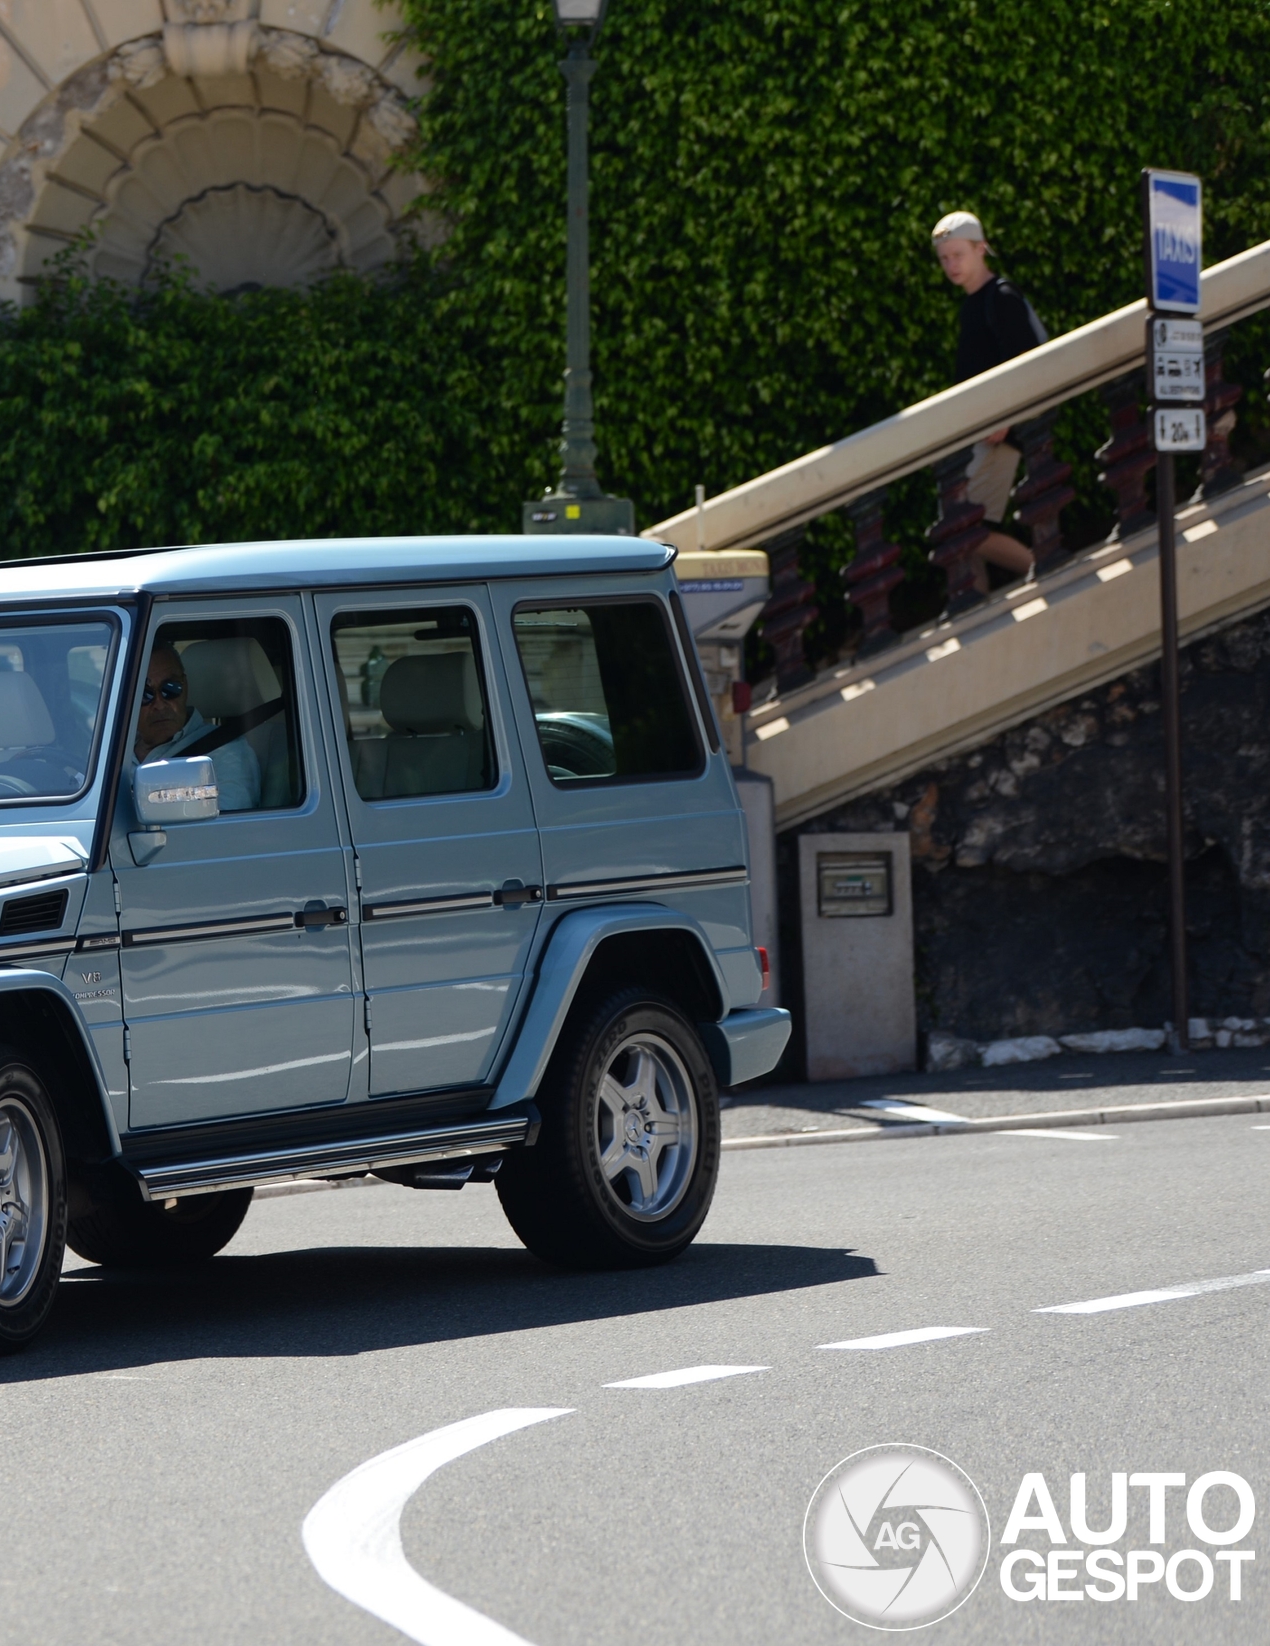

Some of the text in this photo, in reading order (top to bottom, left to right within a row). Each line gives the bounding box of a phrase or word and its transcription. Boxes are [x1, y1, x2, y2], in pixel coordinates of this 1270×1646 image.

[1155, 222, 1196, 264] TAXIS
[73, 989, 116, 999] OMPRESSOR
[81, 970, 102, 985] V8
[596, 1020, 628, 1069] ZERO
[698, 1072, 717, 1173] PIRELLI
[586, 1081, 617, 1218] SCORPION
